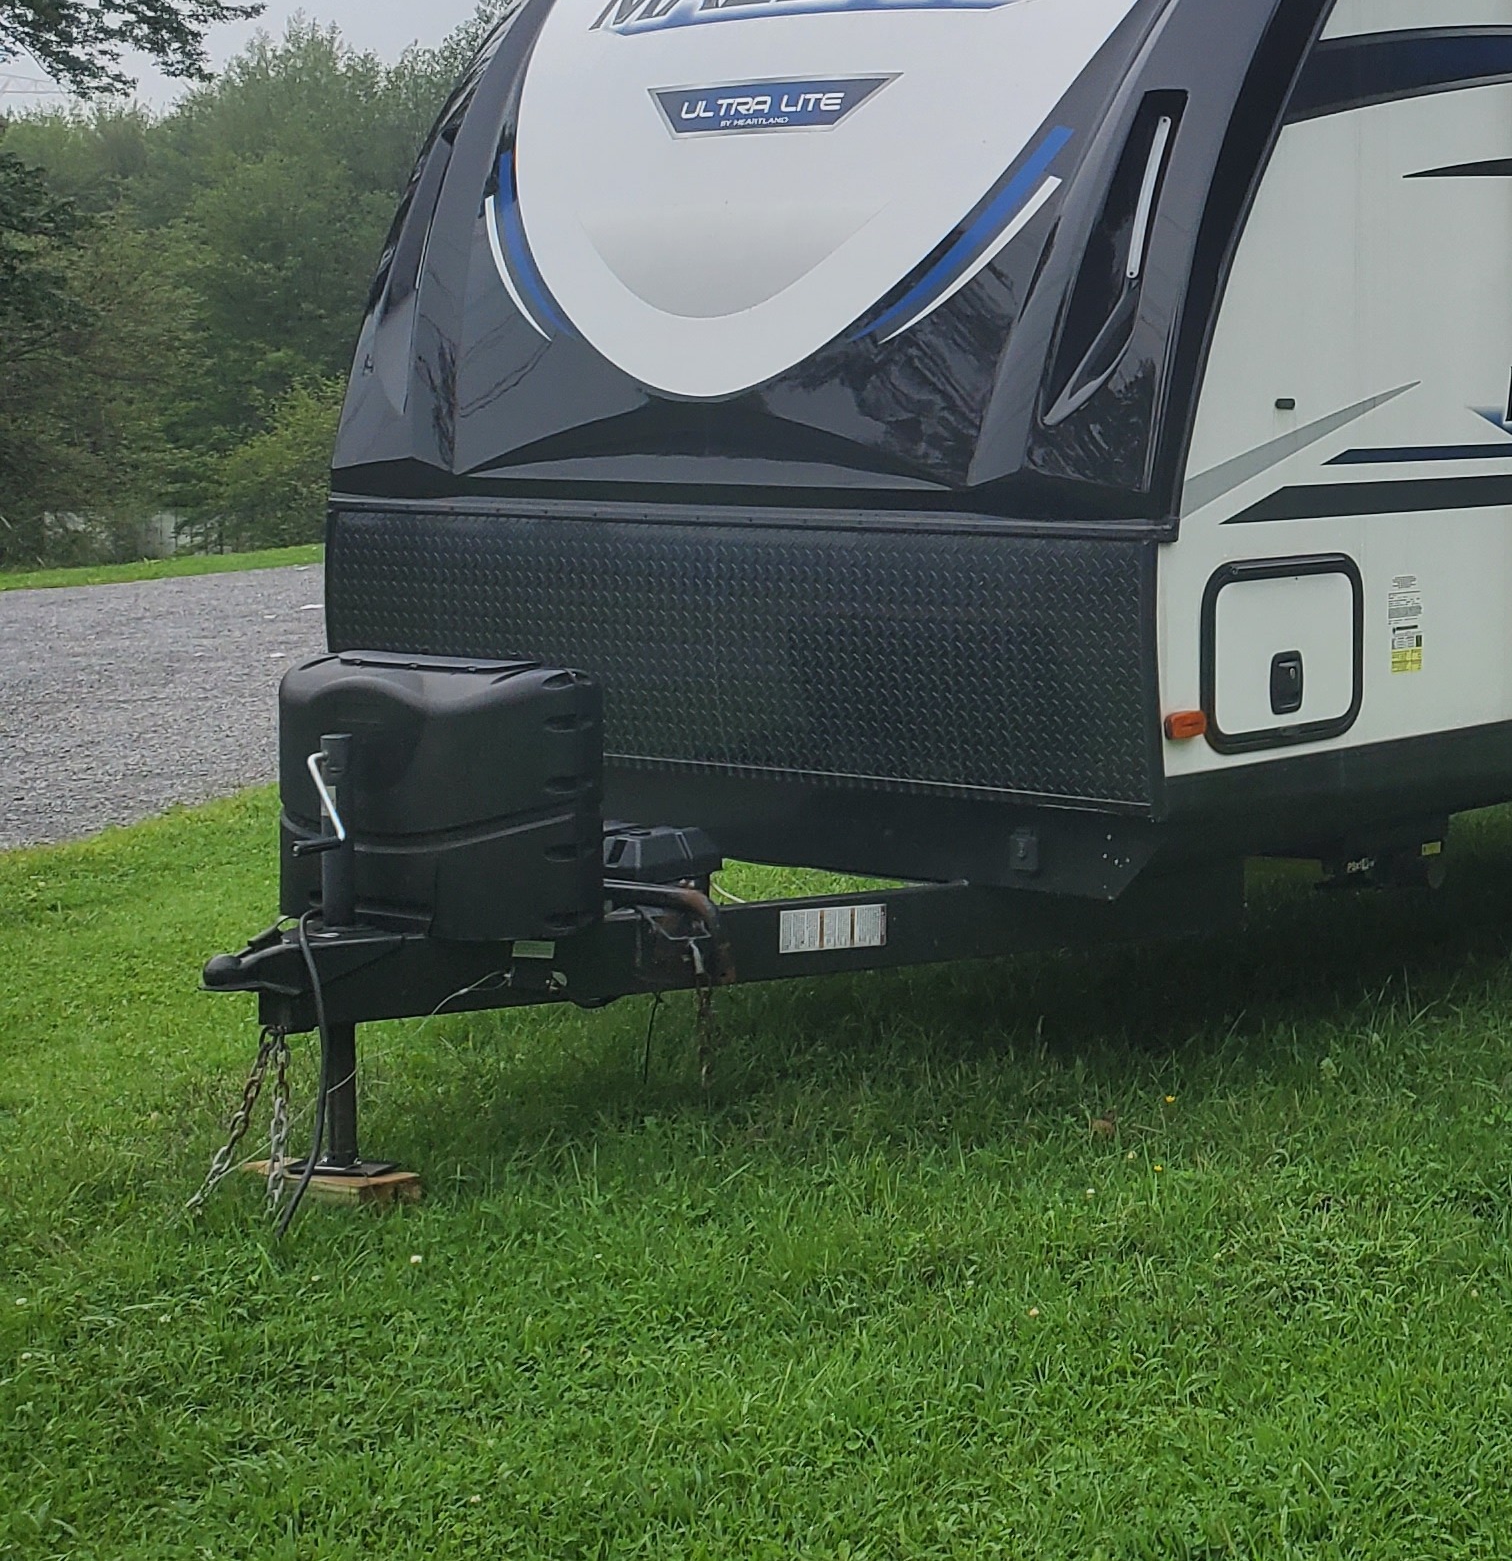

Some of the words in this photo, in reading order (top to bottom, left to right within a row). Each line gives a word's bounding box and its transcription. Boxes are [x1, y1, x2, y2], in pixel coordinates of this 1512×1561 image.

[681, 96, 772, 119] ULTRA
[781, 92, 845, 112] LITE
[719, 119, 732, 128] BY
[733, 116, 790, 126] HEARTLAND
